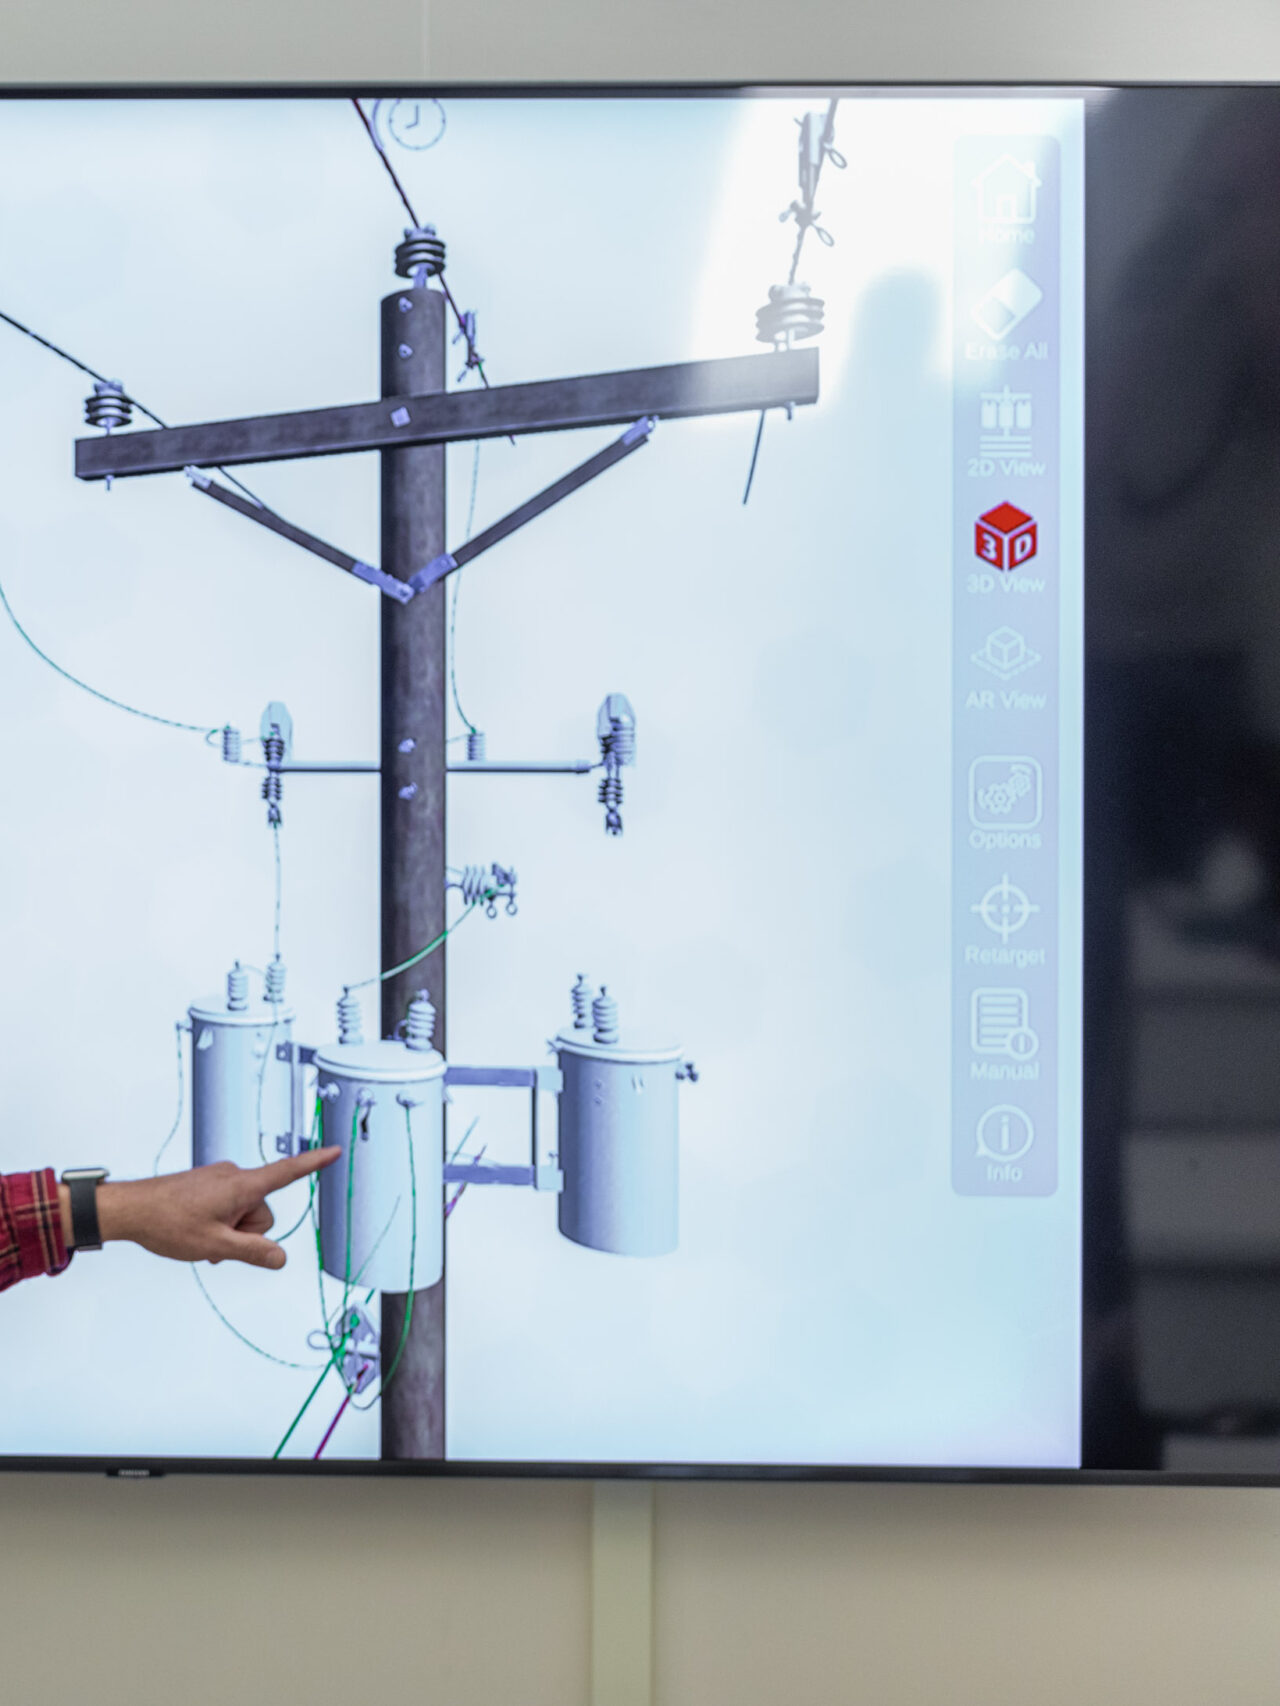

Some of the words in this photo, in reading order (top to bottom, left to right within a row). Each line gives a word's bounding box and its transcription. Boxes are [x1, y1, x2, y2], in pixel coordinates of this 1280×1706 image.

[1024, 342, 1048, 361] All
[968, 459, 995, 477] 2D
[999, 458, 1046, 477] View
[967, 574, 995, 594] 3D
[999, 573, 1046, 594] View
[966, 690, 995, 710] AR
[999, 689, 1047, 710] View
[969, 831, 1042, 852] Options
[966, 945, 1045, 968] Retarget
[971, 1061, 1039, 1080] Manual
[988, 1164, 1023, 1182] Info
